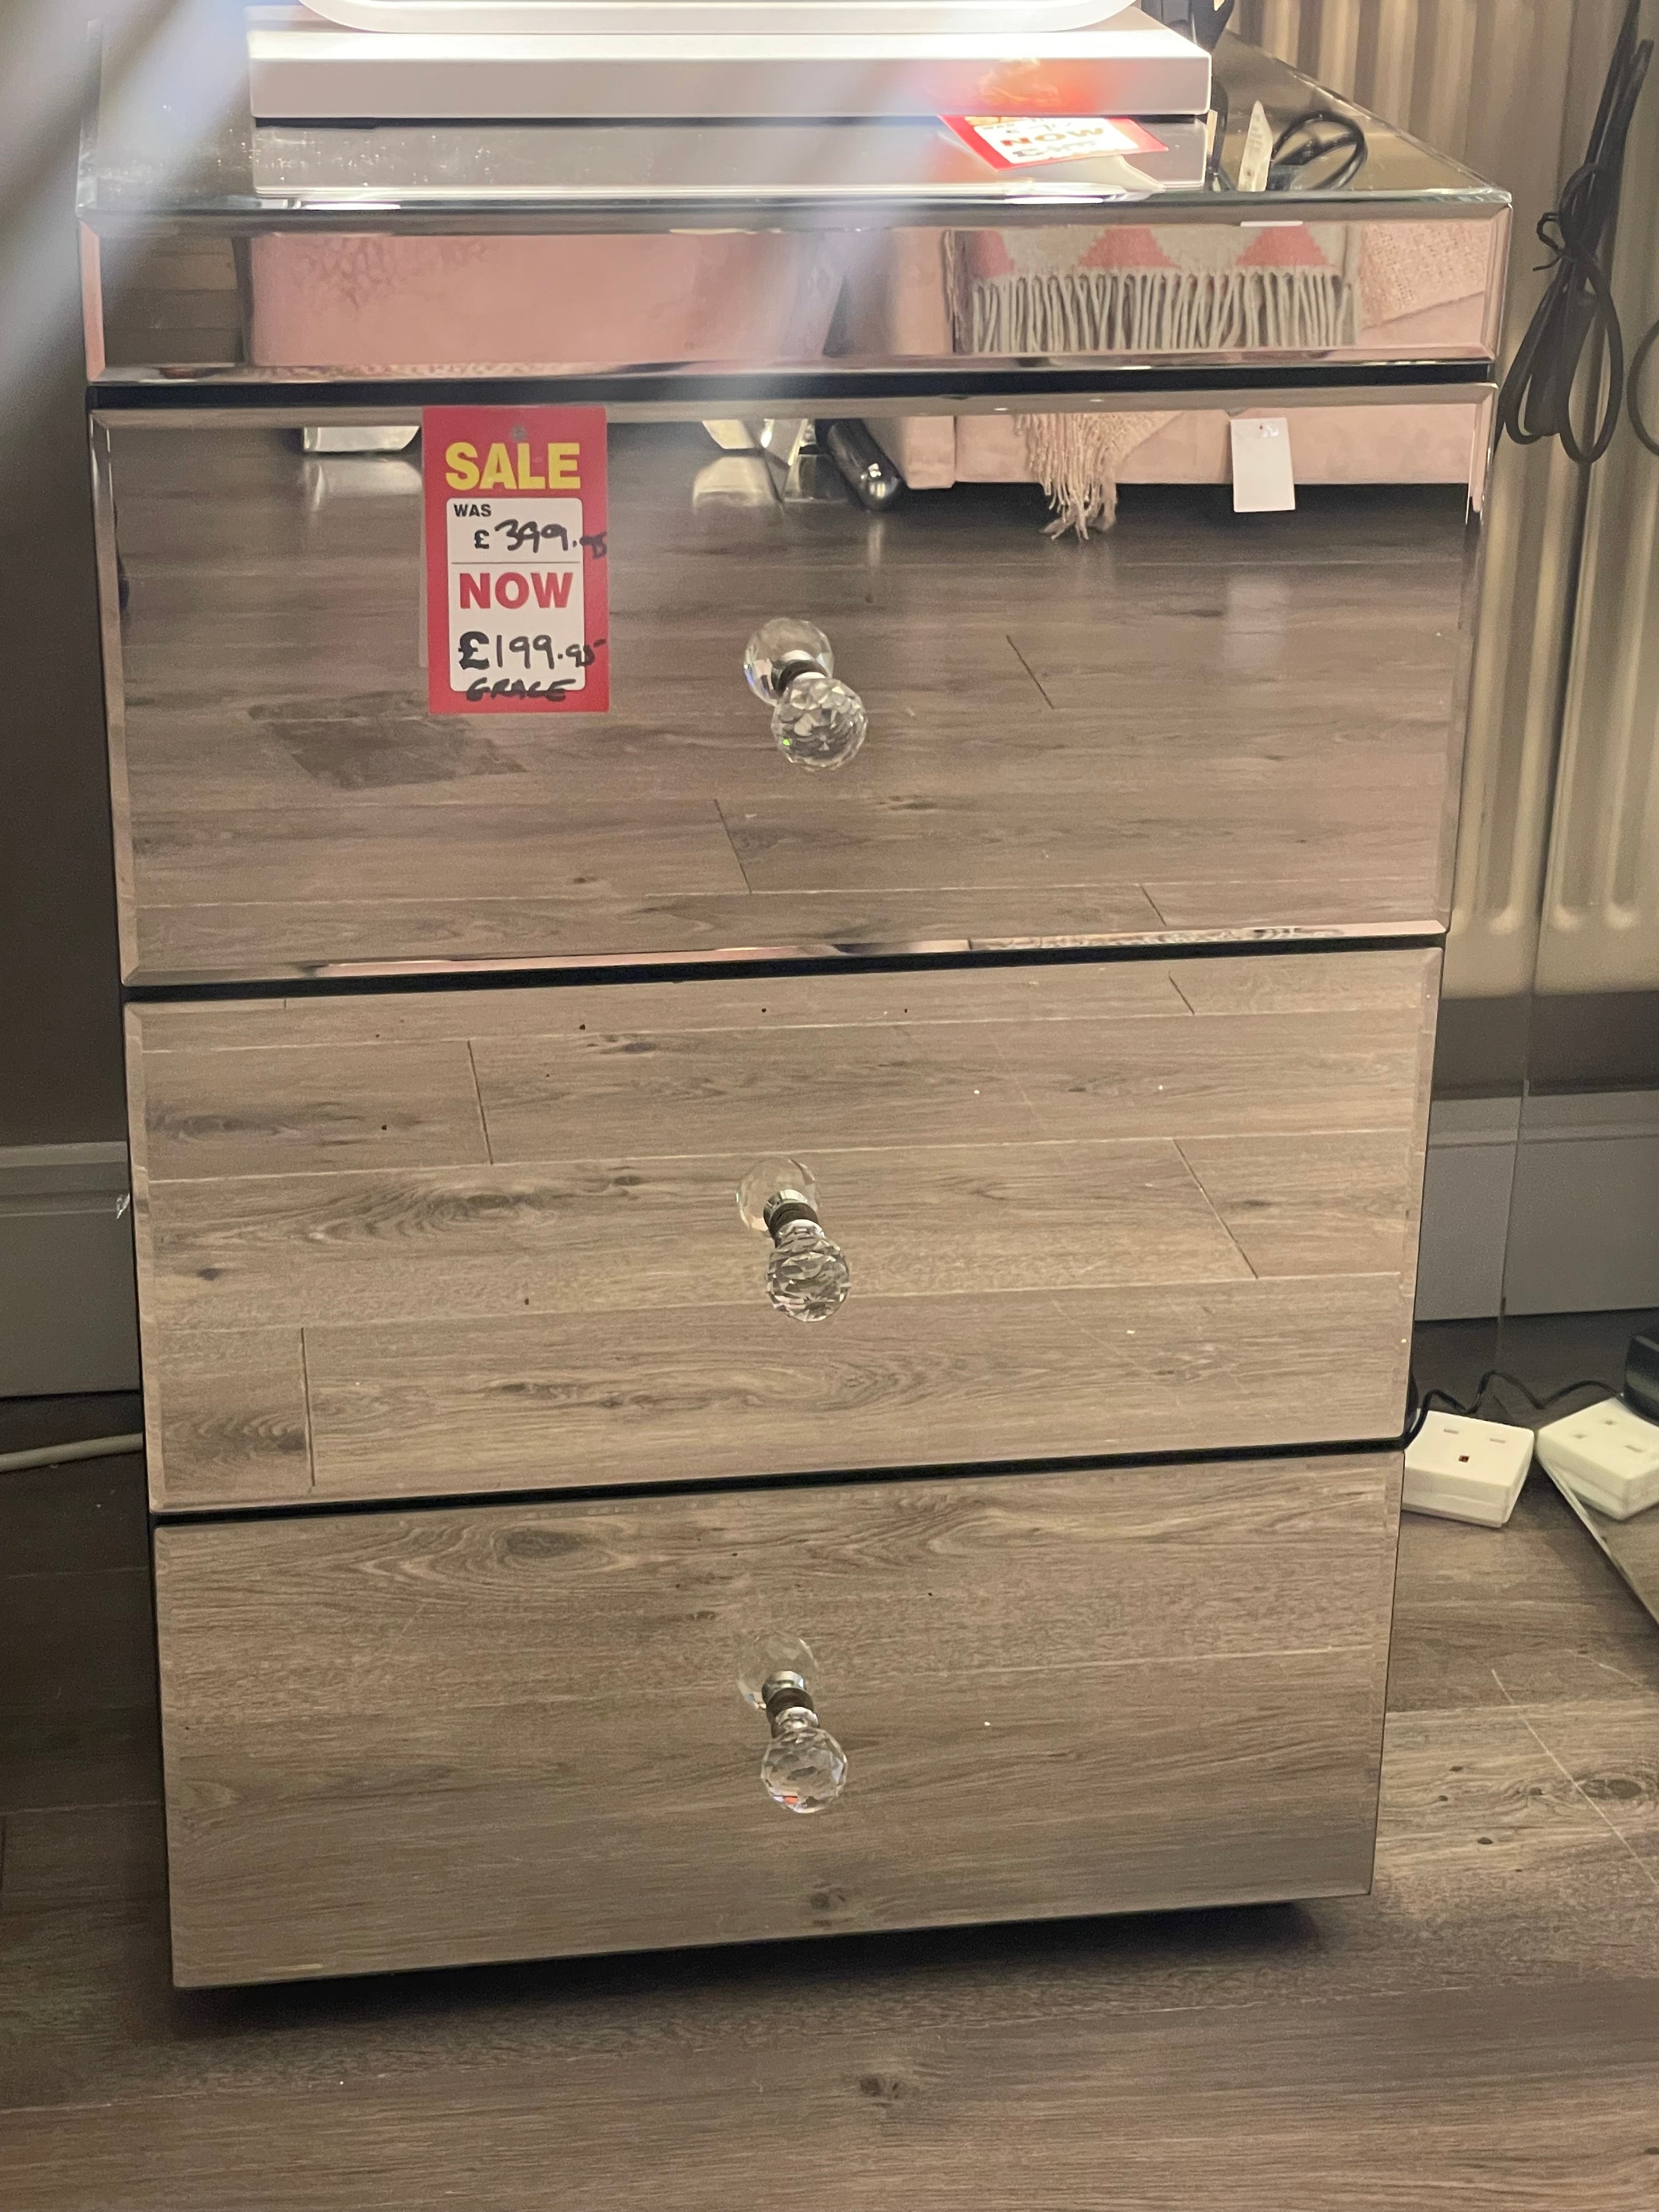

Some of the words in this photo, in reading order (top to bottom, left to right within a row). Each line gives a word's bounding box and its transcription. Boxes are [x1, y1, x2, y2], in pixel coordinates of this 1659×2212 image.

[1000, 127, 1104, 146] NOW
[445, 442, 581, 490] SALE
[454, 504, 492, 517] WAS
[459, 572, 573, 609] NOW
[458, 631, 607, 670] £199.95
[465, 677, 576, 702] GRACE
